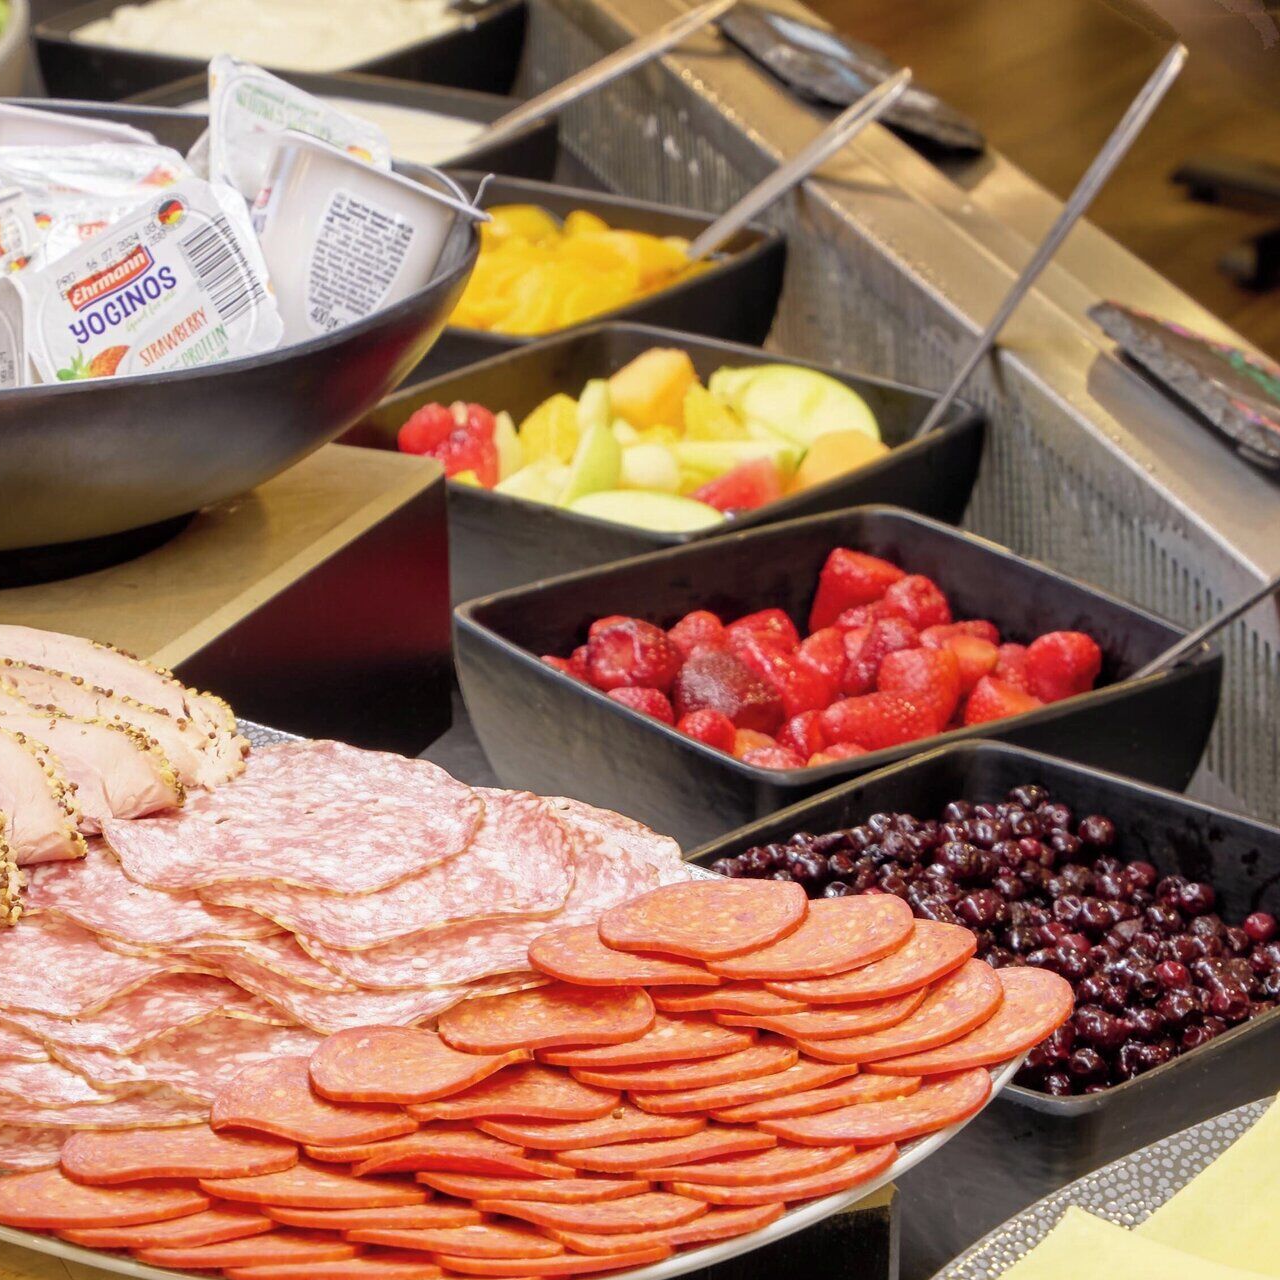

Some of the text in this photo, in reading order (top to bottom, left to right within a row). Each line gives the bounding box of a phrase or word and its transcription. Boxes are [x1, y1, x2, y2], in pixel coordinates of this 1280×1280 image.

[68, 265, 178, 345] YOGINOS
[70, 249, 147, 306] Ehrmann
[138, 305, 210, 368] STRAWBERRY
